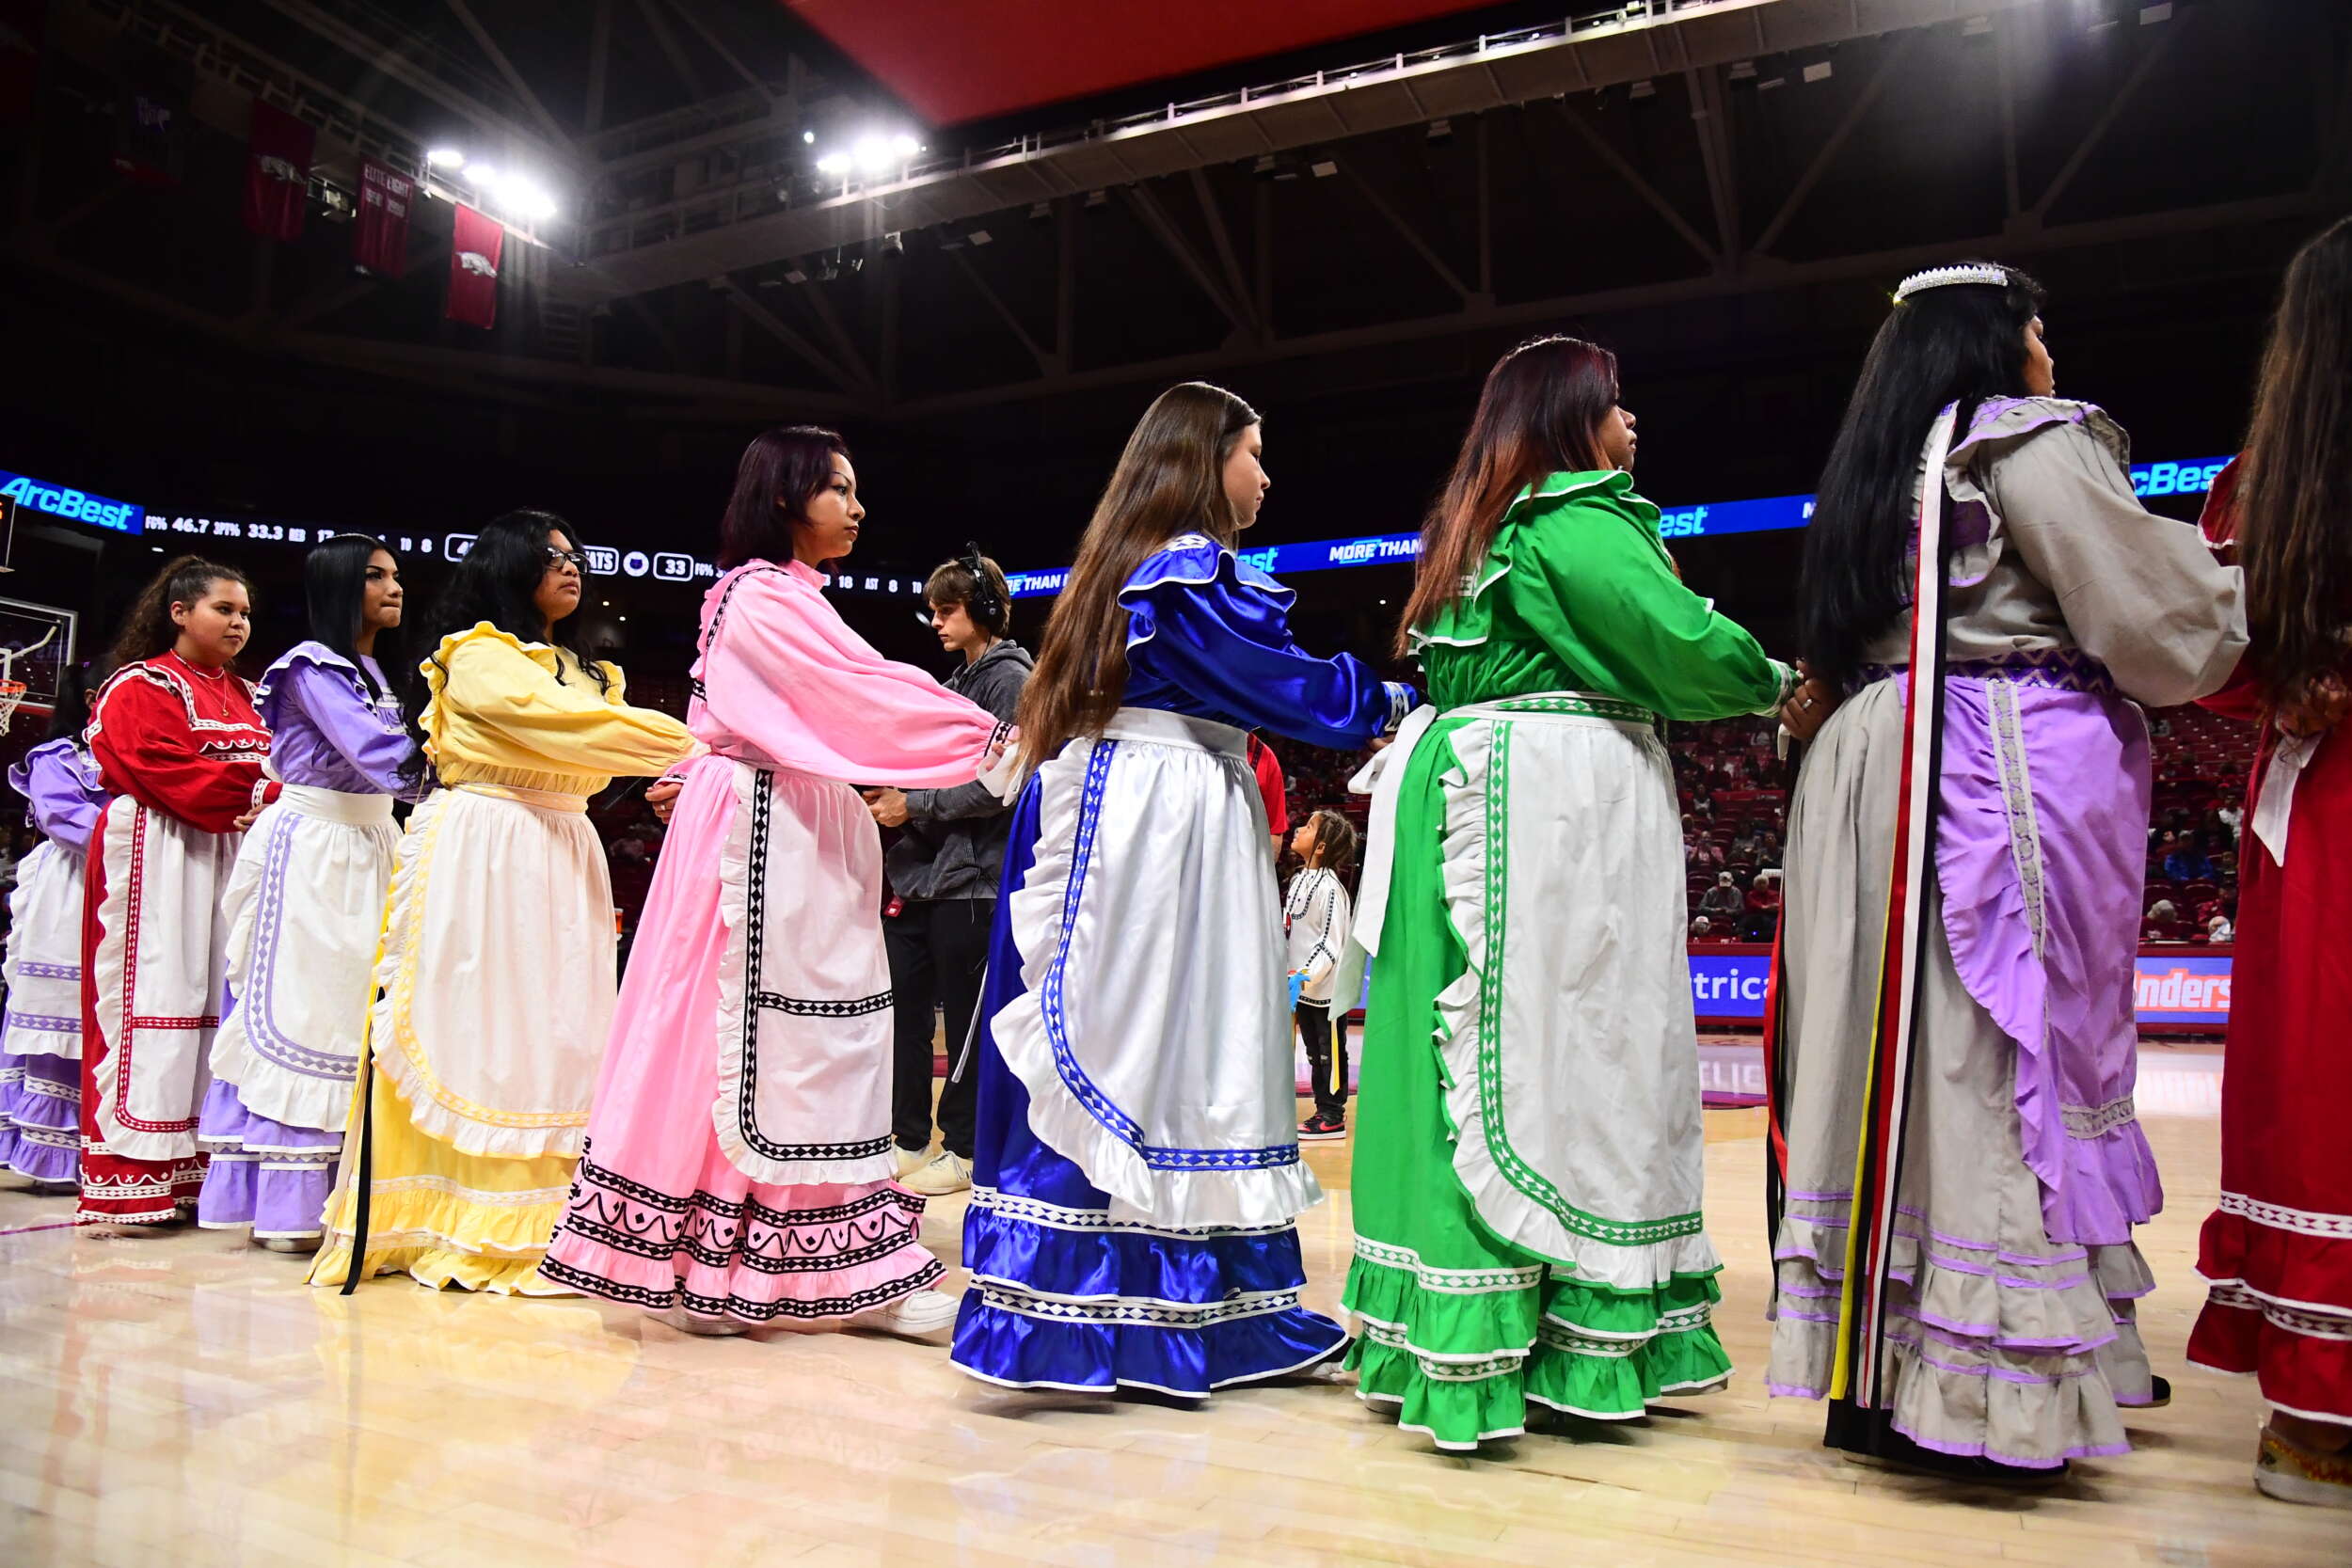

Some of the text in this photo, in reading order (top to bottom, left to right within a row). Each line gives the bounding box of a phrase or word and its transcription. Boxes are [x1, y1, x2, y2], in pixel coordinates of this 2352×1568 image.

[2130, 458, 2236, 496] cBes
[0, 477, 133, 531] ArcBest
[172, 517, 210, 533] 46.7
[247, 523, 283, 540] 33.3
[586, 551, 613, 570] ATS
[1329, 544, 1376, 562] MORE
[665, 559, 686, 576] 33
[888, 579, 898, 593] 8
[1024, 574, 1061, 592] THAN
